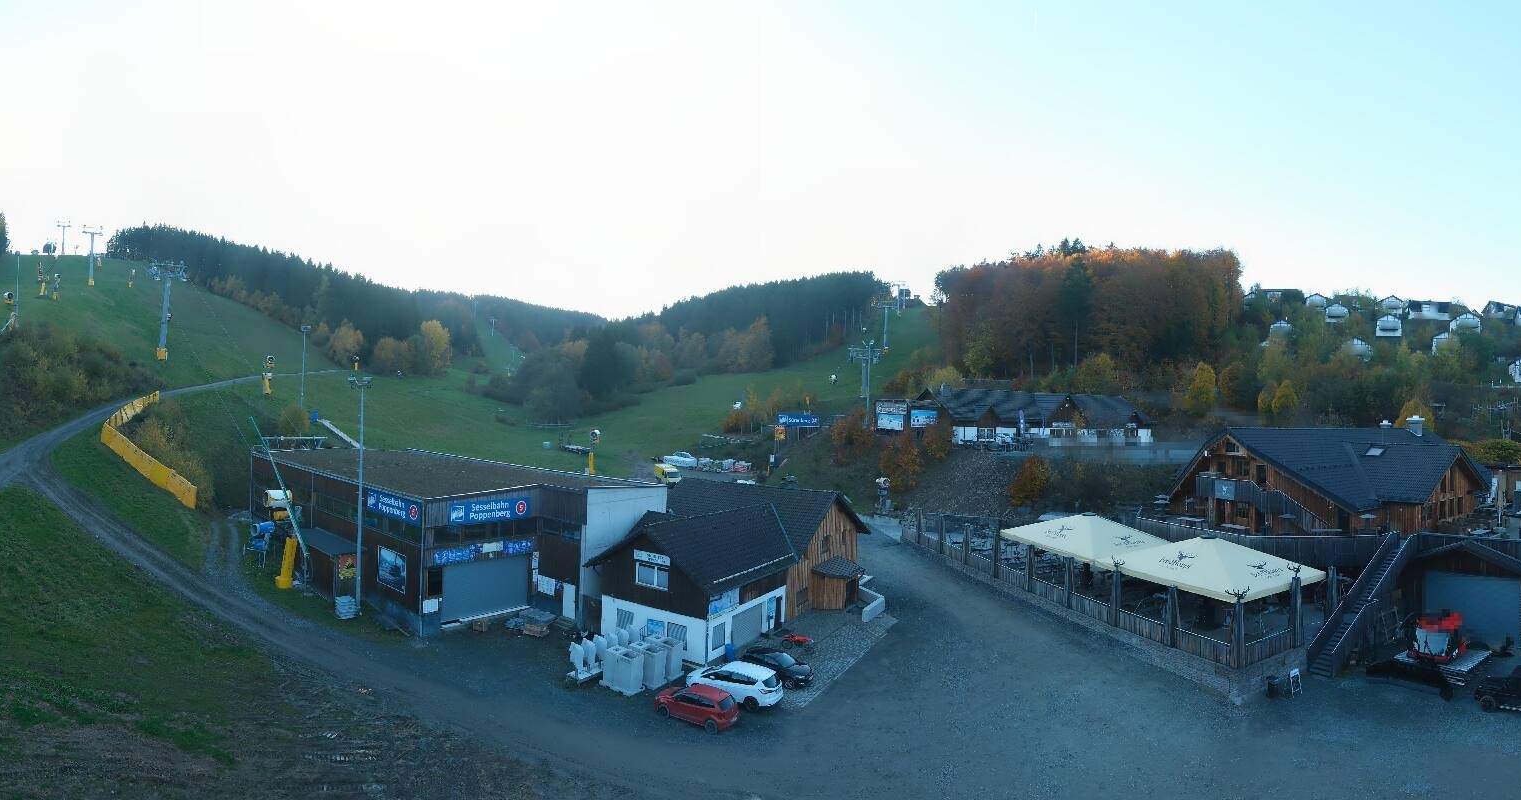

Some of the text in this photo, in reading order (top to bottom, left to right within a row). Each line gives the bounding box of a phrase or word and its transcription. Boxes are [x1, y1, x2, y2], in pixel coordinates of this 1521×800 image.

[379, 494, 405, 508] Sesselbahn
[471, 501, 509, 512] Sesselbahn
[378, 503, 406, 519] Poppenberg
[469, 509, 511, 521] Poppenberg
